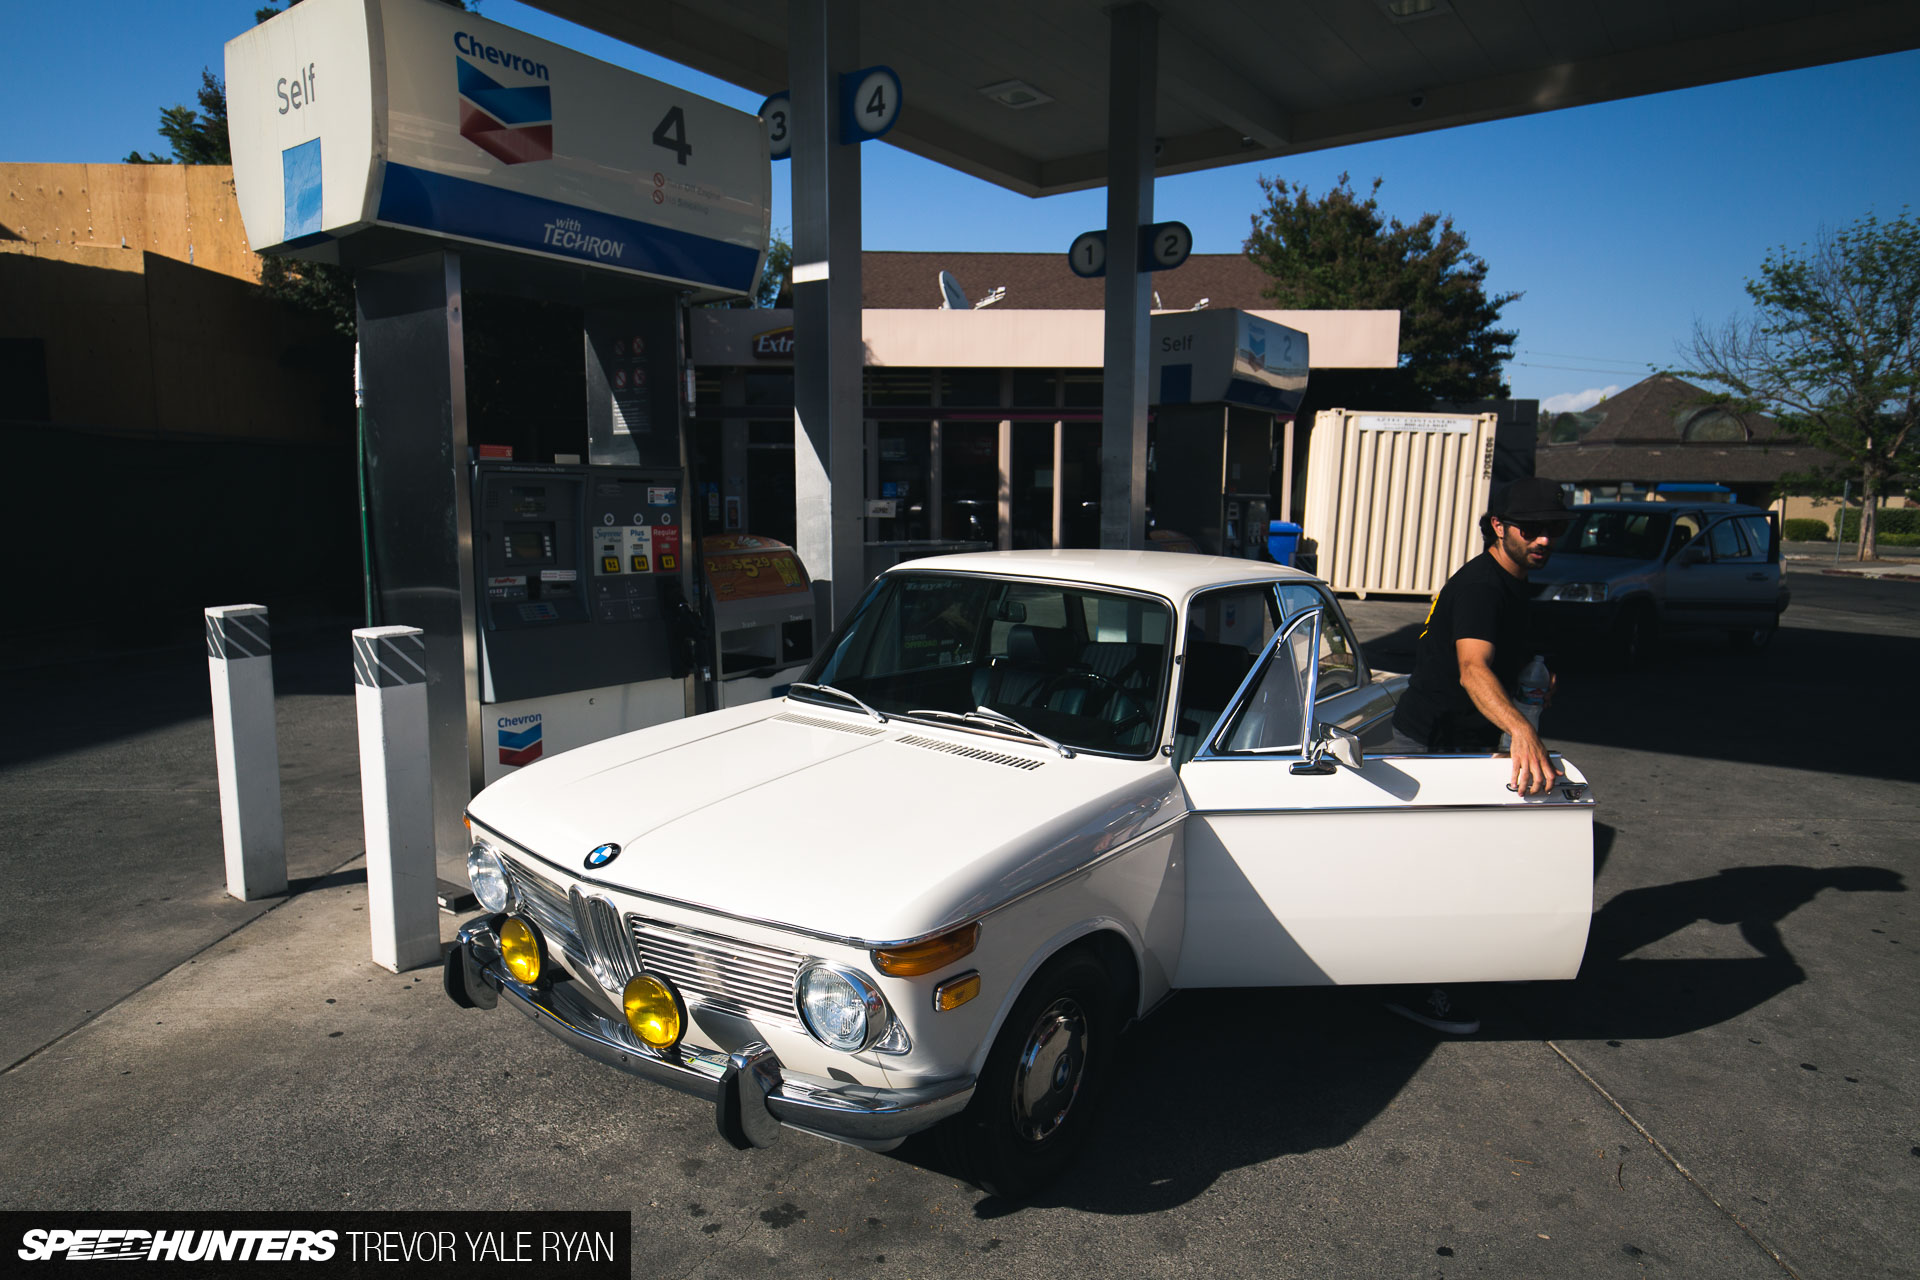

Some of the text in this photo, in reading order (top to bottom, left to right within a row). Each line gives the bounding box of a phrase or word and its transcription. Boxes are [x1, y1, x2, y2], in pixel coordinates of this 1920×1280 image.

[453, 31, 549, 81] Chevron
[276, 62, 315, 115] Self
[866, 85, 886, 117] 4
[652, 106, 692, 166] 4
[771, 111, 787, 141] 3
[556, 217, 582, 232] with
[543, 223, 624, 258] TECHRON
[1164, 235, 1178, 256] 2
[1085, 244, 1093, 265] 1
[1161, 334, 1193, 352] Self
[1283, 335, 1293, 362] 2
[595, 528, 622, 540] Supreme
[630, 529, 645, 537] Plus
[653, 529, 677, 537] Regular
[707, 561, 719, 573] 2
[497, 713, 543, 728] Chevron
